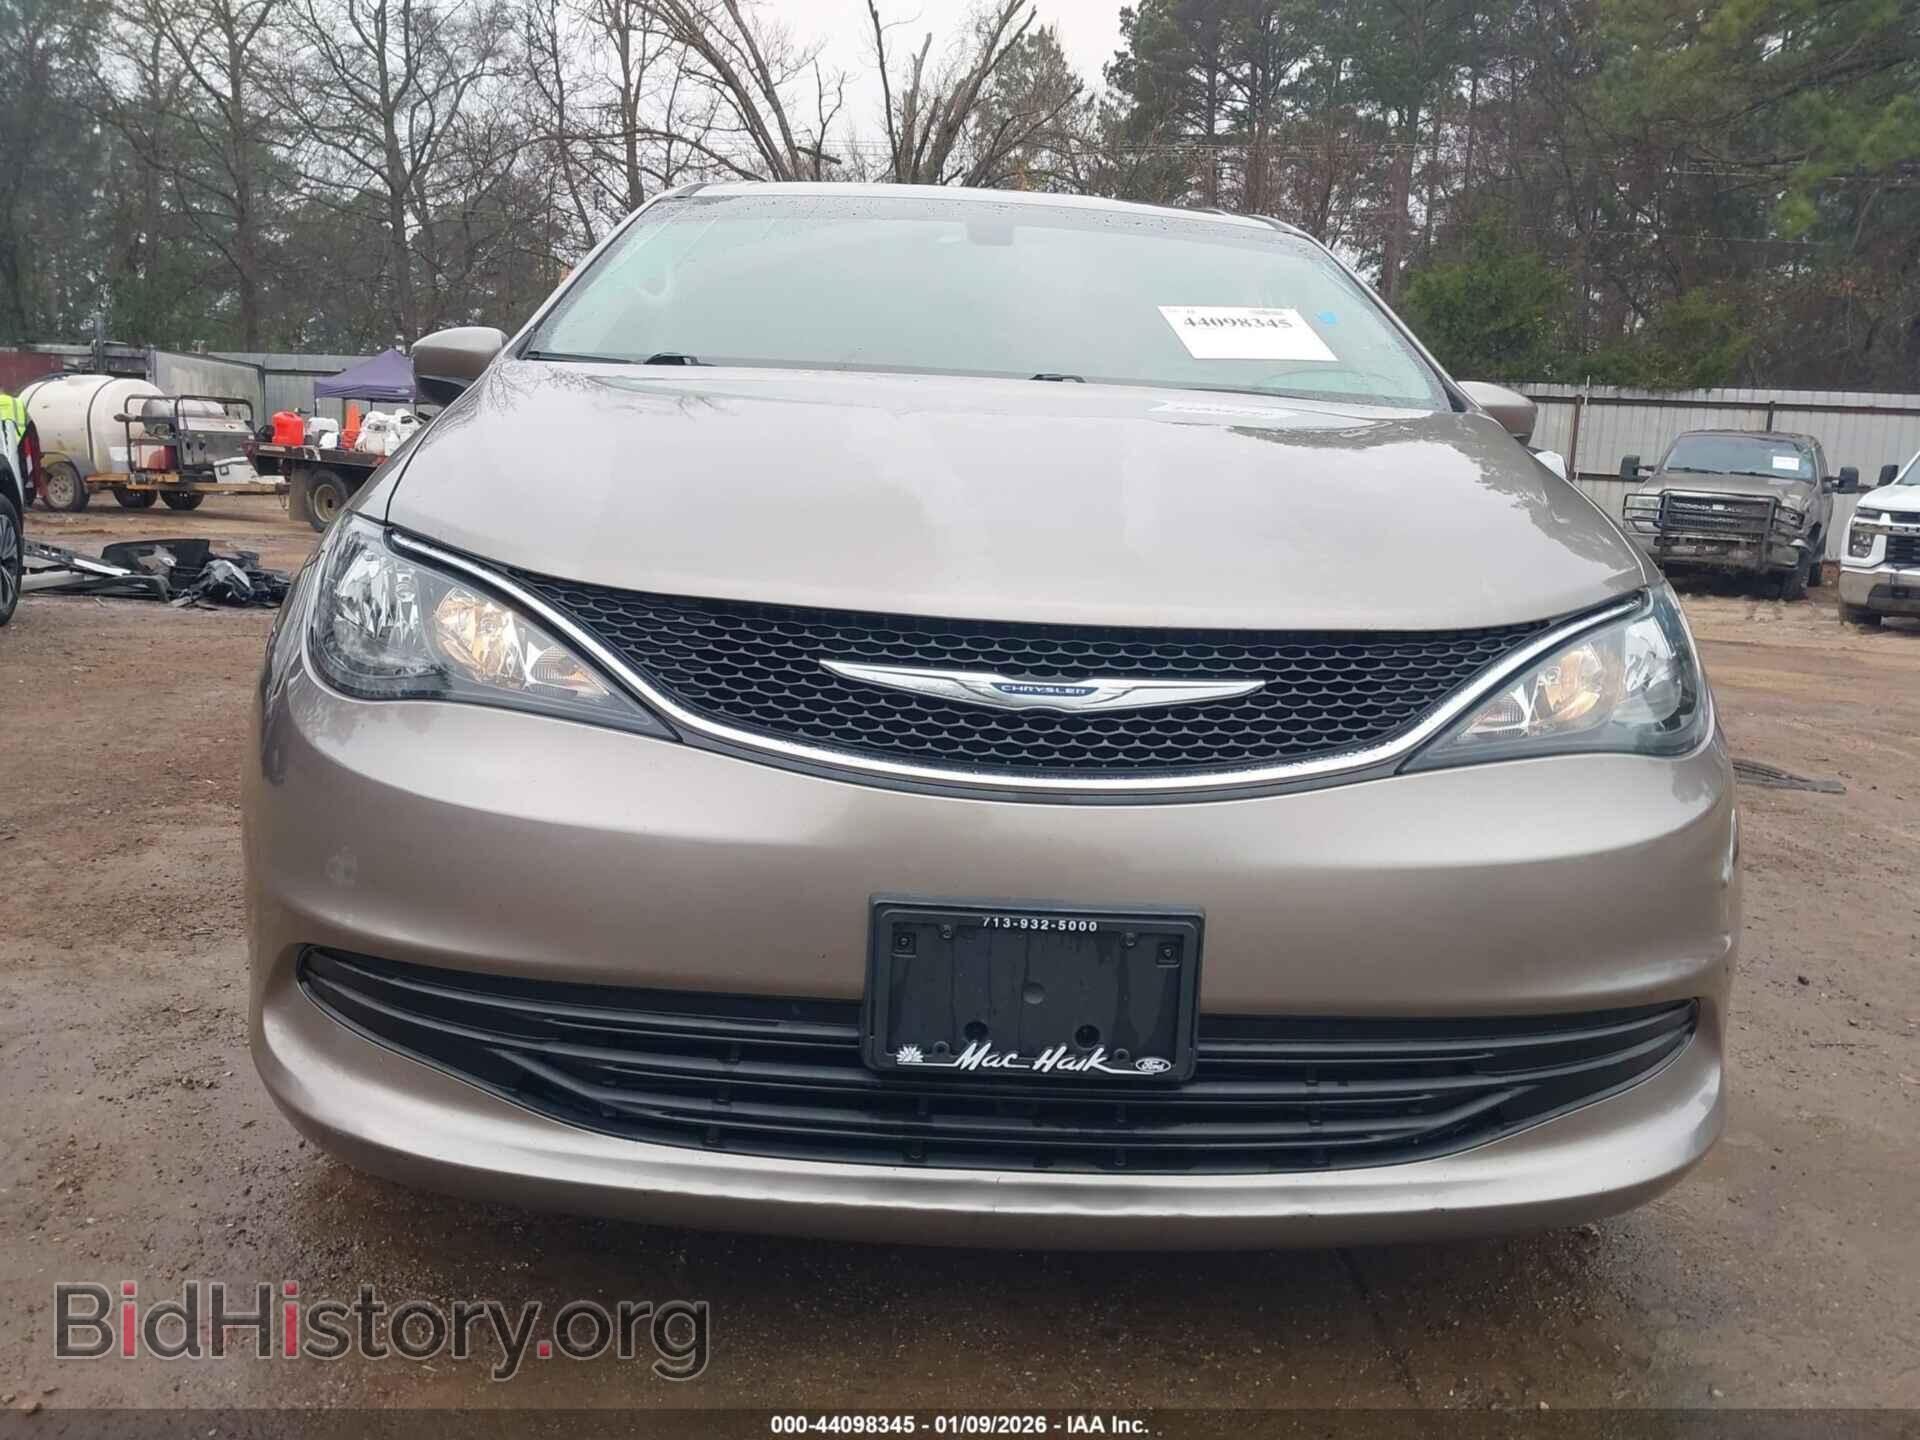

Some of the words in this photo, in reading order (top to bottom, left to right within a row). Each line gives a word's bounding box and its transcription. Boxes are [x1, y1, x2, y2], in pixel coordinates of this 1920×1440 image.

[1183, 316, 1294, 329] 44098345
[1001, 684, 1087, 695] CHRYSLER
[983, 917, 1098, 933] 713-932-5000
[954, 1042, 1030, 1071] Mac
